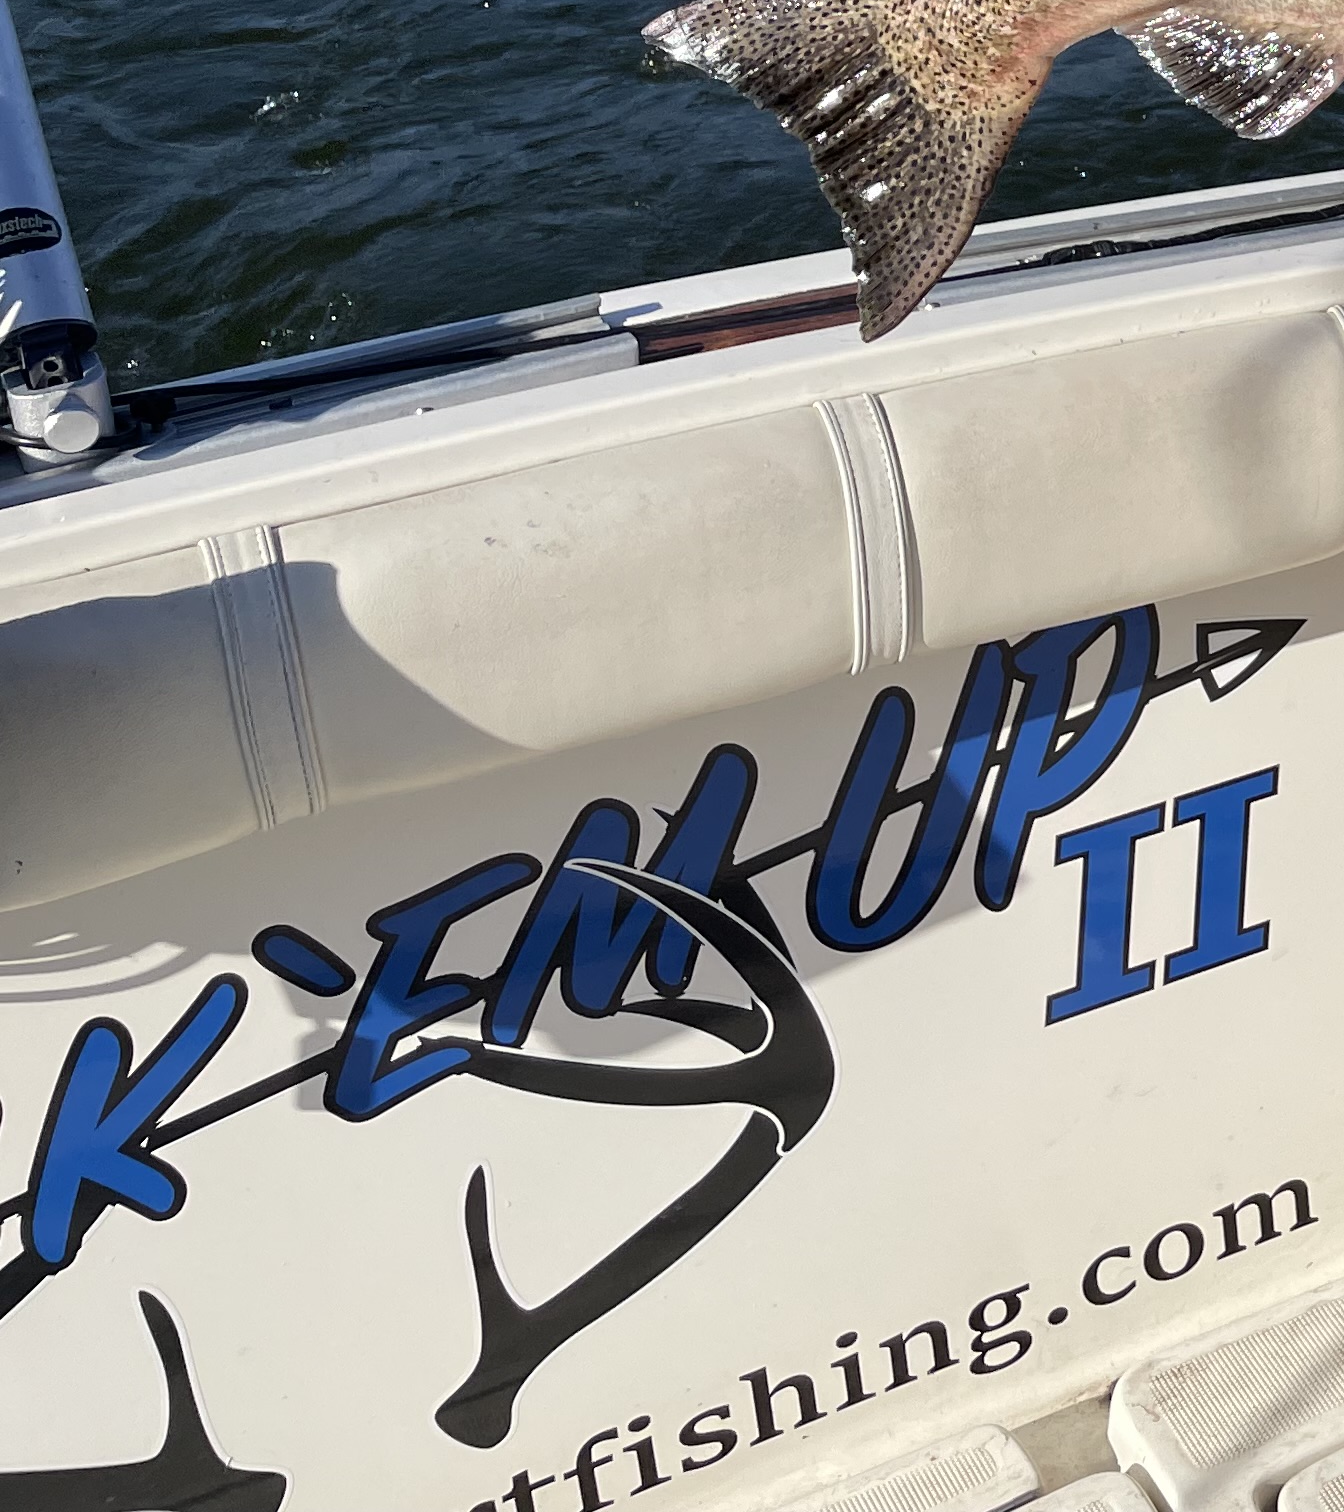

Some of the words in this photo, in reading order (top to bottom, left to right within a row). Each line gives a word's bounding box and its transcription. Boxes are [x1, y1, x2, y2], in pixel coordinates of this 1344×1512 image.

[0, 213, 43, 235] xstech
[805, 602, 1160, 953] UP
[1044, 763, 1280, 1027] II
[467, 1177, 1319, 1512] tfishing.com
